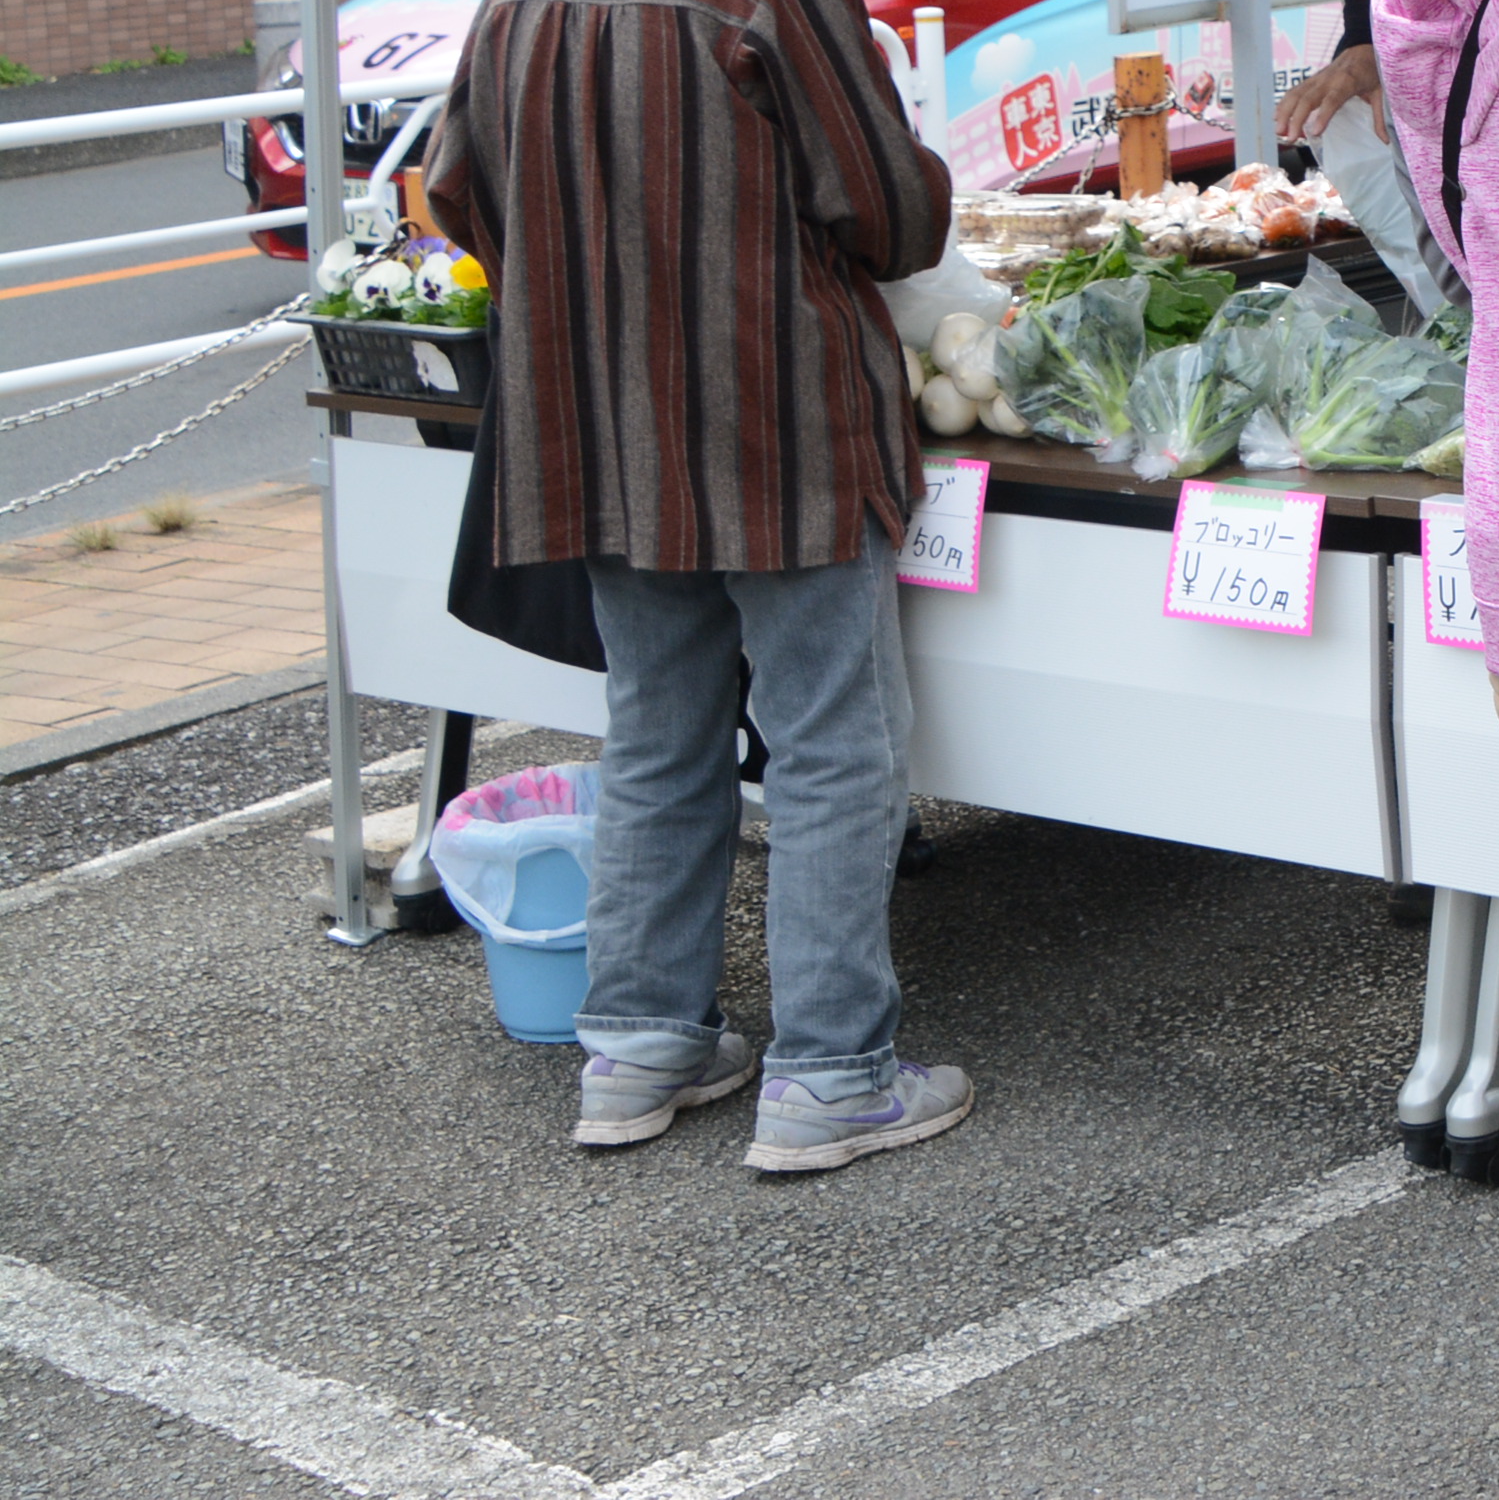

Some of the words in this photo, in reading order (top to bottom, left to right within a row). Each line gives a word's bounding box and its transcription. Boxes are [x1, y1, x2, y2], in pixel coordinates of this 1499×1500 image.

[363, 32, 449, 71] 67
[1194, 516, 1295, 550] ブロッコリー
